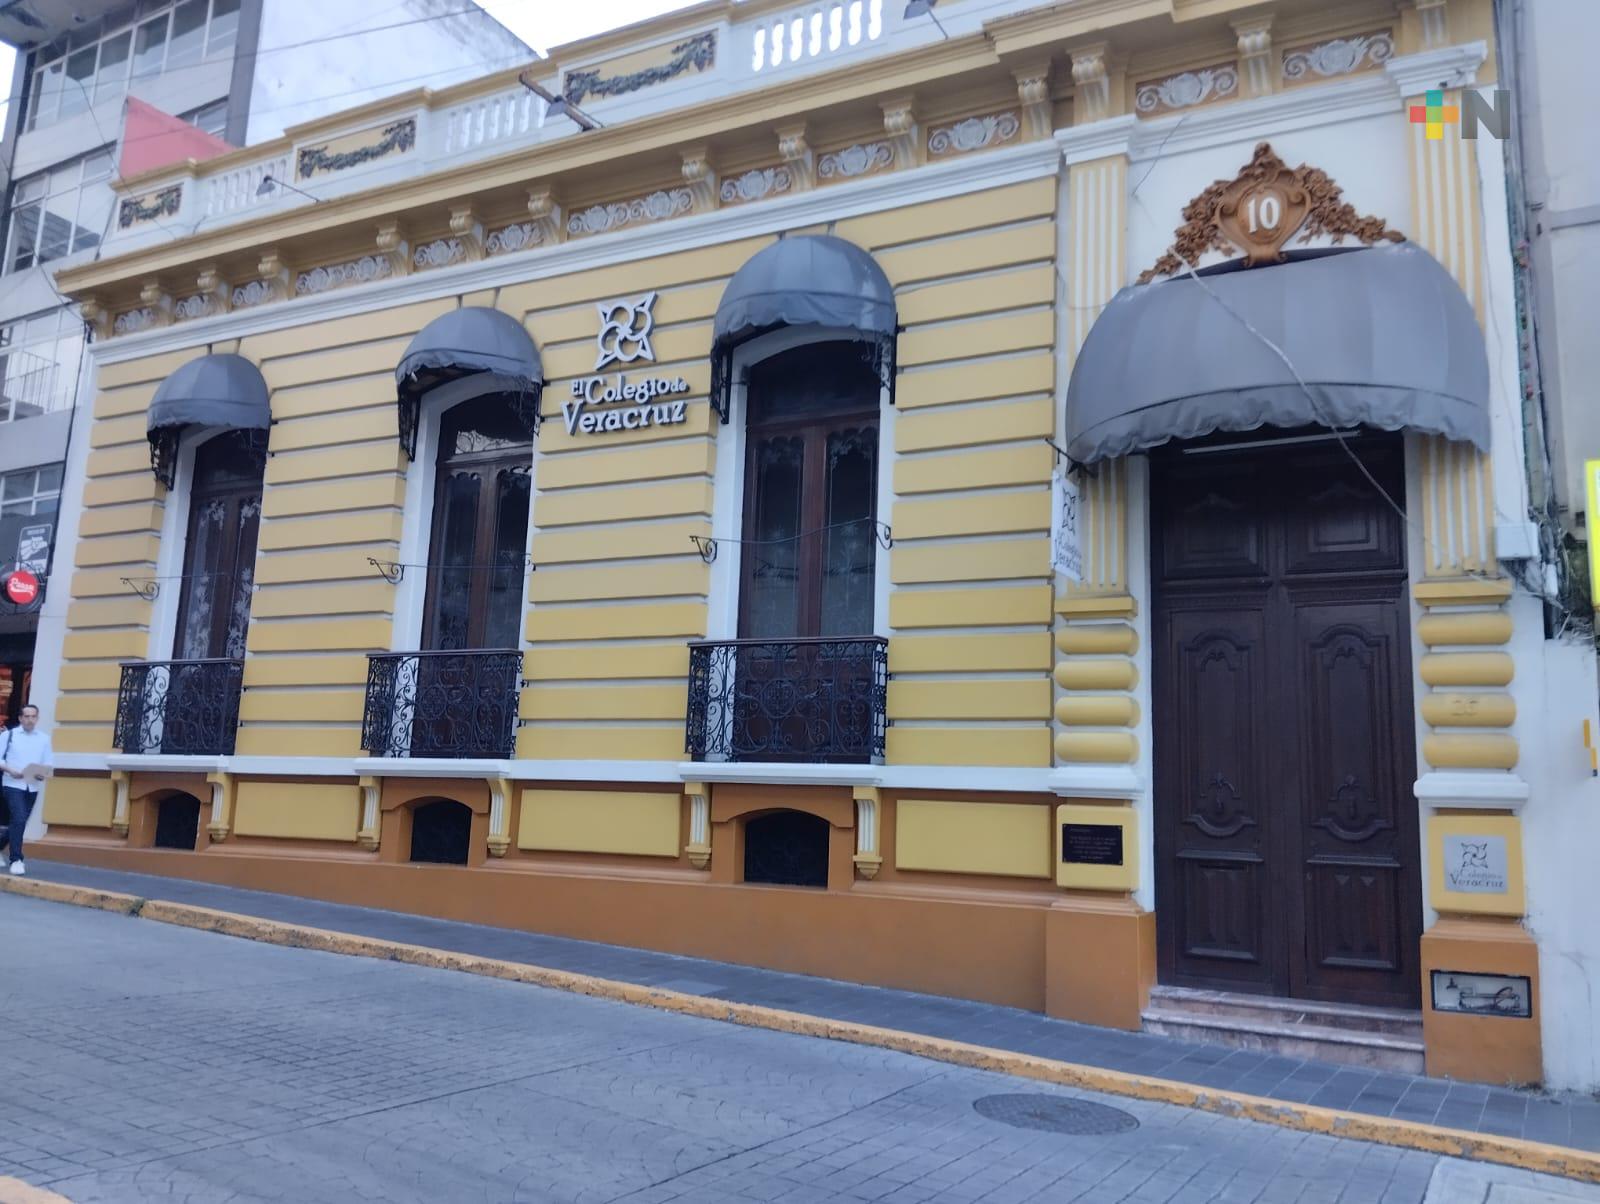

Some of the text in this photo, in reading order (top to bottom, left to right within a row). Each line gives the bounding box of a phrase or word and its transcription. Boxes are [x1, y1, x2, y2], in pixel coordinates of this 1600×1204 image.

[1247, 196, 1280, 233] 10
[571, 374, 688, 404] El Colegio de
[562, 399, 687, 435] Veracruz
